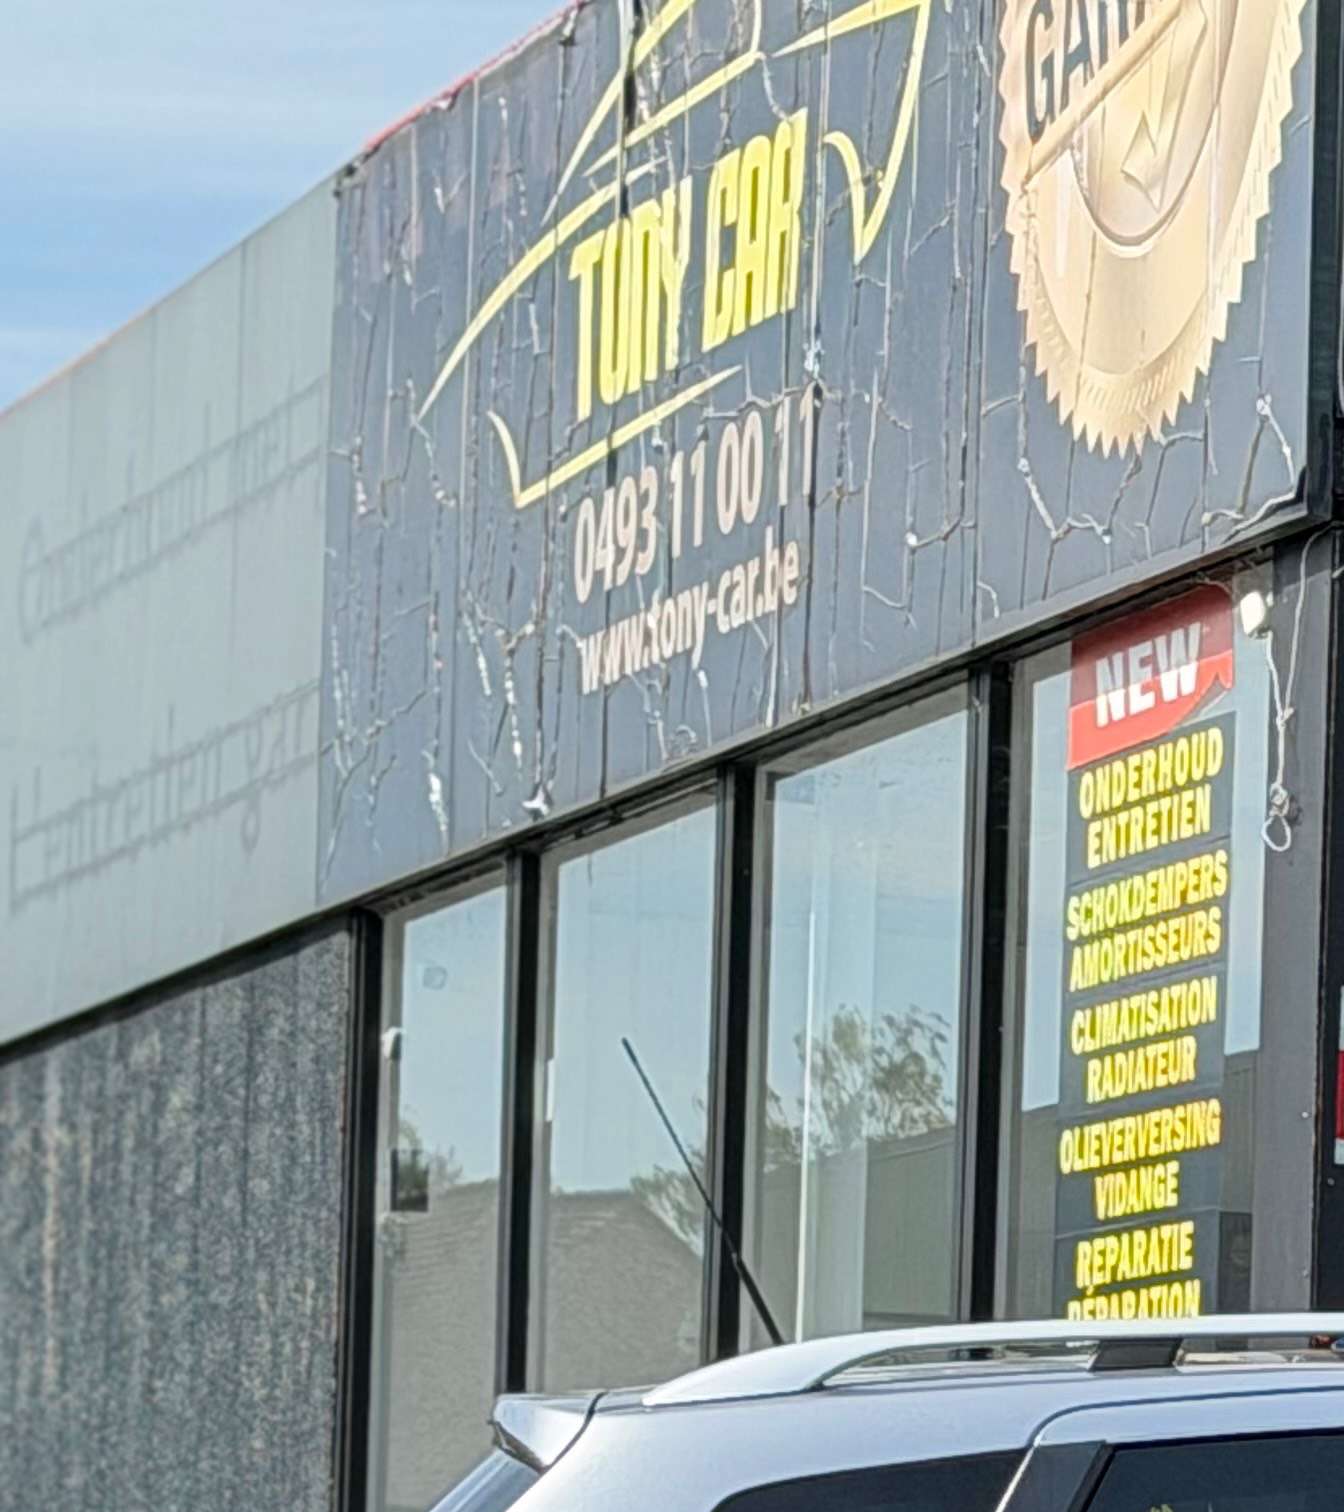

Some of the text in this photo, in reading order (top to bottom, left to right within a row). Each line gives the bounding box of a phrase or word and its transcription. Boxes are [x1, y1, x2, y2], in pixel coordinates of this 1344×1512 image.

[569, 107, 808, 422] TONY CAR
[574, 466, 658, 603] 0493
[671, 440, 705, 558] 11
[717, 411, 763, 534] 00
[580, 526, 799, 695] www.tony-car.be
[1096, 622, 1200, 727] NEW
[1080, 727, 1223, 818] ONDERHOUD
[1087, 784, 1211, 869] ENTRETIEN
[1066, 849, 1227, 941] SCHOKDEMPERS
[1070, 907, 1221, 992] AMORTISSEURS
[1071, 976, 1217, 1055] CLIMATISATION
[1086, 1036, 1196, 1104] RADIATEUR
[1060, 1098, 1221, 1175] OLIEVERVERSING
[1094, 1160, 1179, 1220] VIDANGE
[1076, 1220, 1194, 1289] REPARATIE
